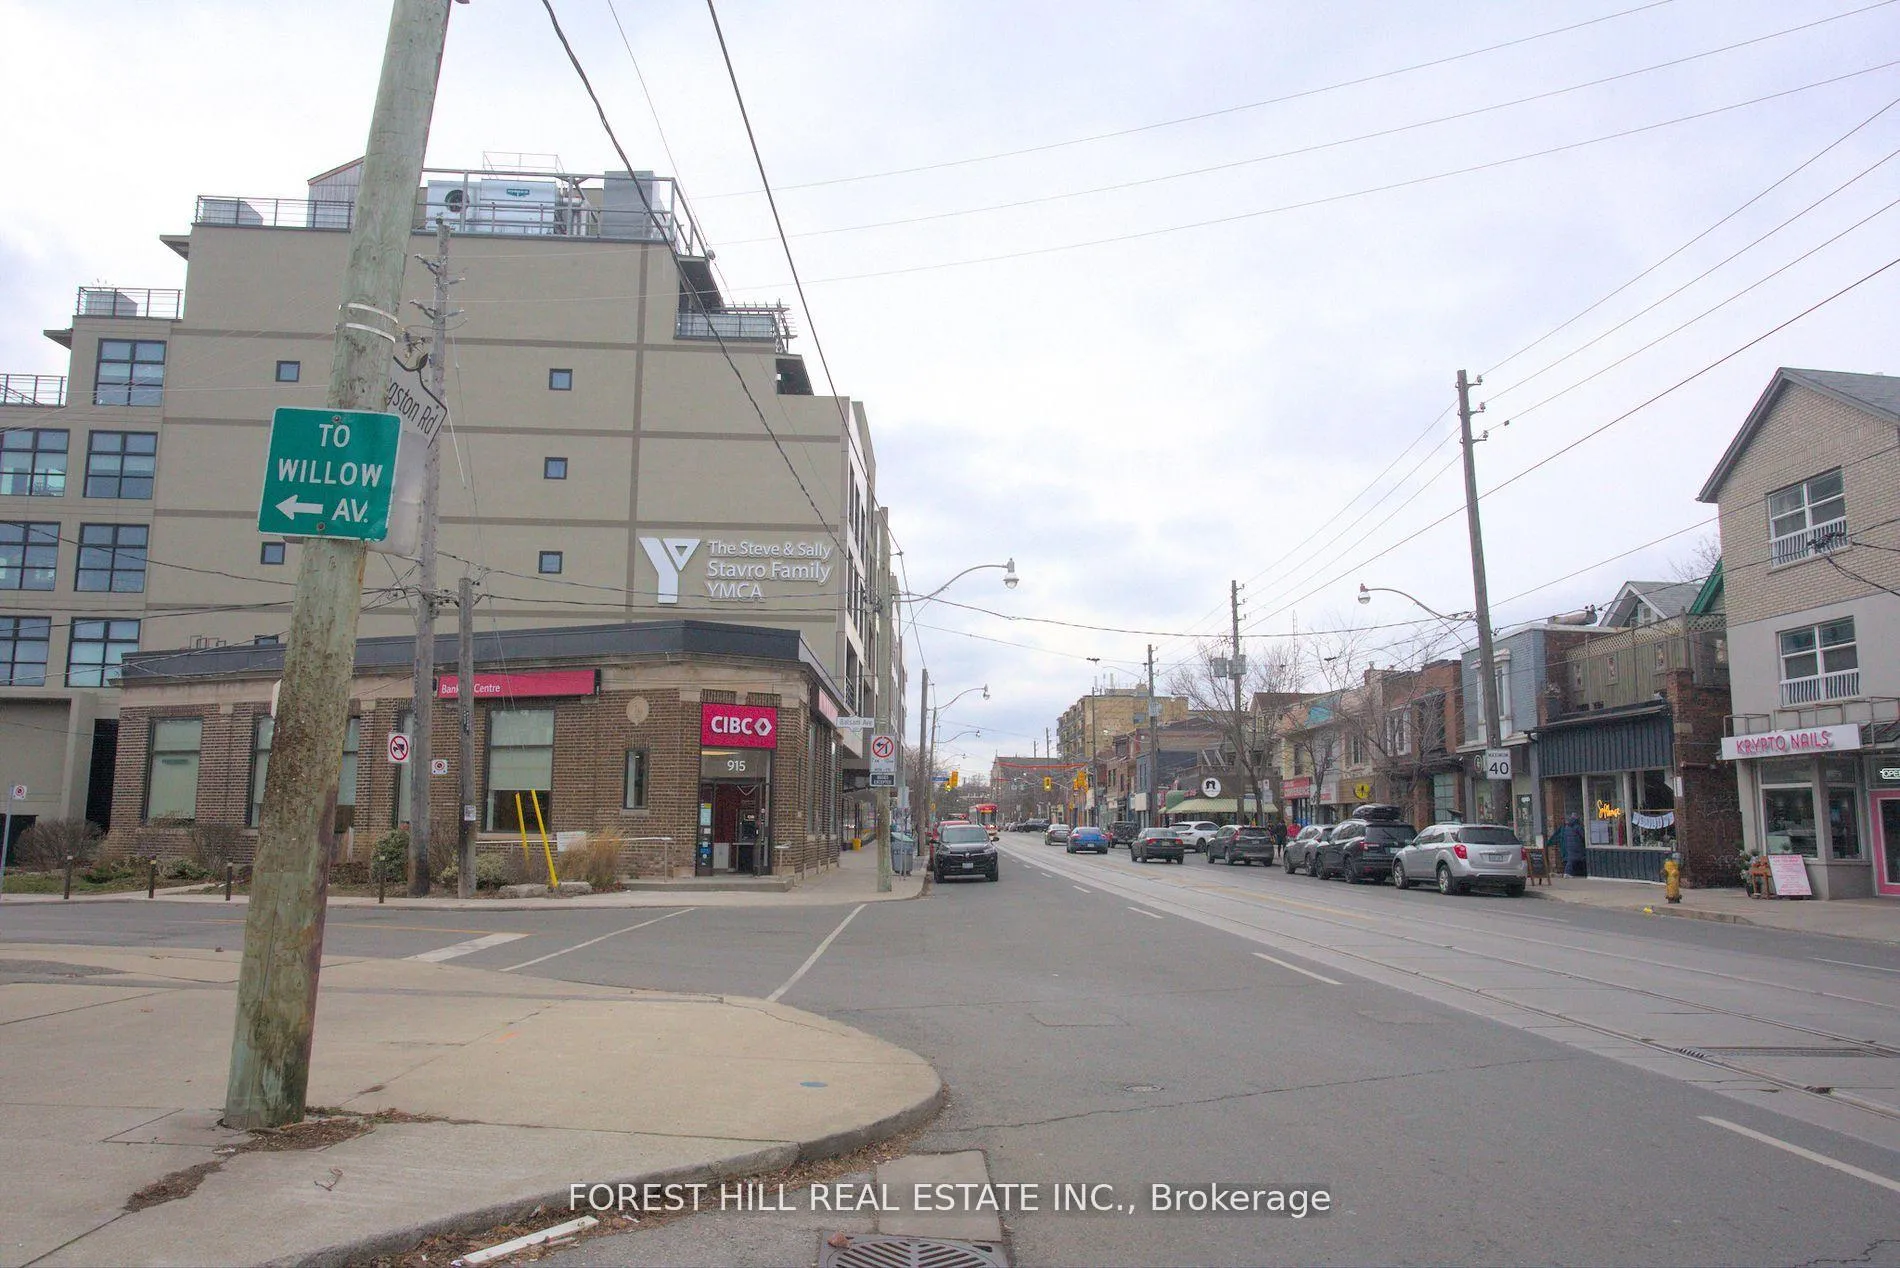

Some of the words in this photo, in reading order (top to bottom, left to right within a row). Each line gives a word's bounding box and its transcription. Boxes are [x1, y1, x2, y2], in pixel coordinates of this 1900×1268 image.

[387, 377, 420, 422] gston
[417, 405, 439, 435] Rd
[318, 423, 350, 448] TO
[278, 458, 383, 488] WILLOW
[331, 498, 369, 523] AV.
[708, 540, 735, 555] The
[738, 541, 781, 556] Steve
[783, 542, 795, 556] &
[797, 542, 832, 559] Sally
[707, 561, 766, 578] Stavro
[771, 561, 833, 585] Family
[707, 582, 764, 599] YMCA
[473, 683, 501, 693] Centre
[711, 716, 753, 735] CIBC
[1736, 735, 1786, 753] KRYPTO
[1790, 730, 1830, 750] NAILS
[727, 760, 746, 772] 915
[1489, 762, 1509, 775] 40
[1882, 769, 1900, 778] OPE
